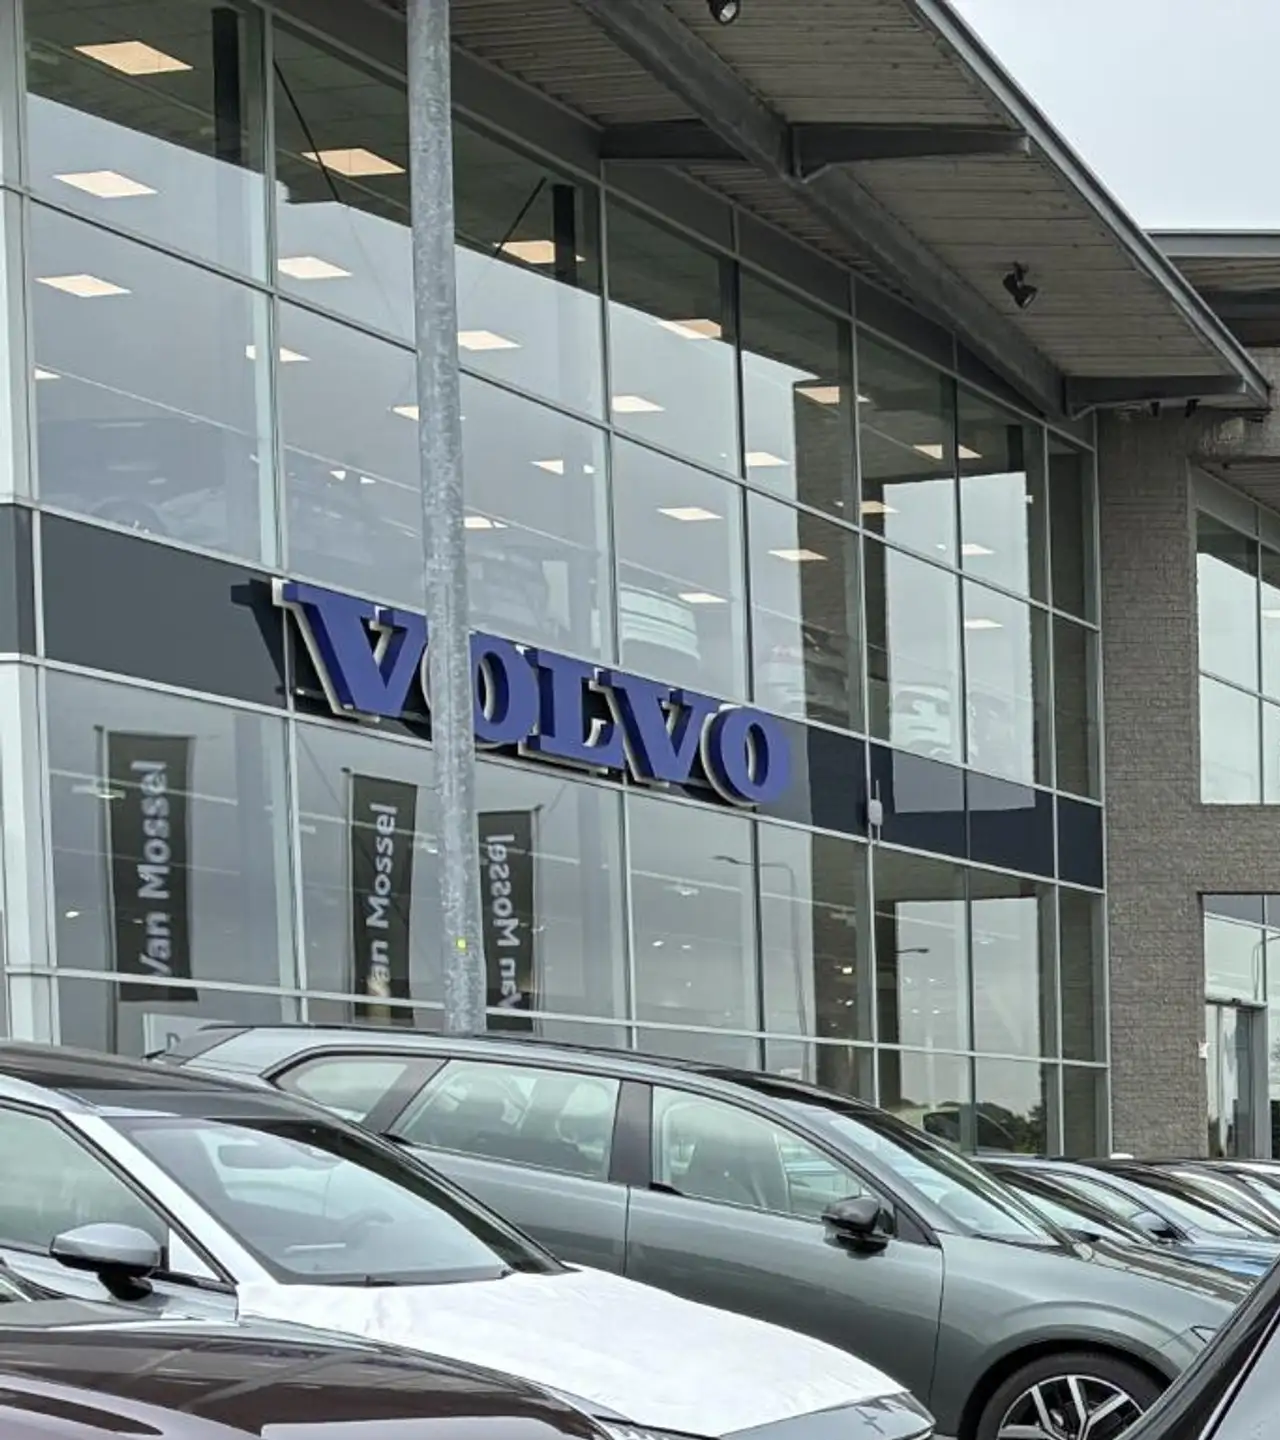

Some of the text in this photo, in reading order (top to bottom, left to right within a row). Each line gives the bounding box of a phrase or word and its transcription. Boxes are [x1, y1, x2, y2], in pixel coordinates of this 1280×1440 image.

[275, 578, 791, 806] VOLVO
[131, 761, 172, 899] Mossel
[365, 803, 398, 929] Mossel
